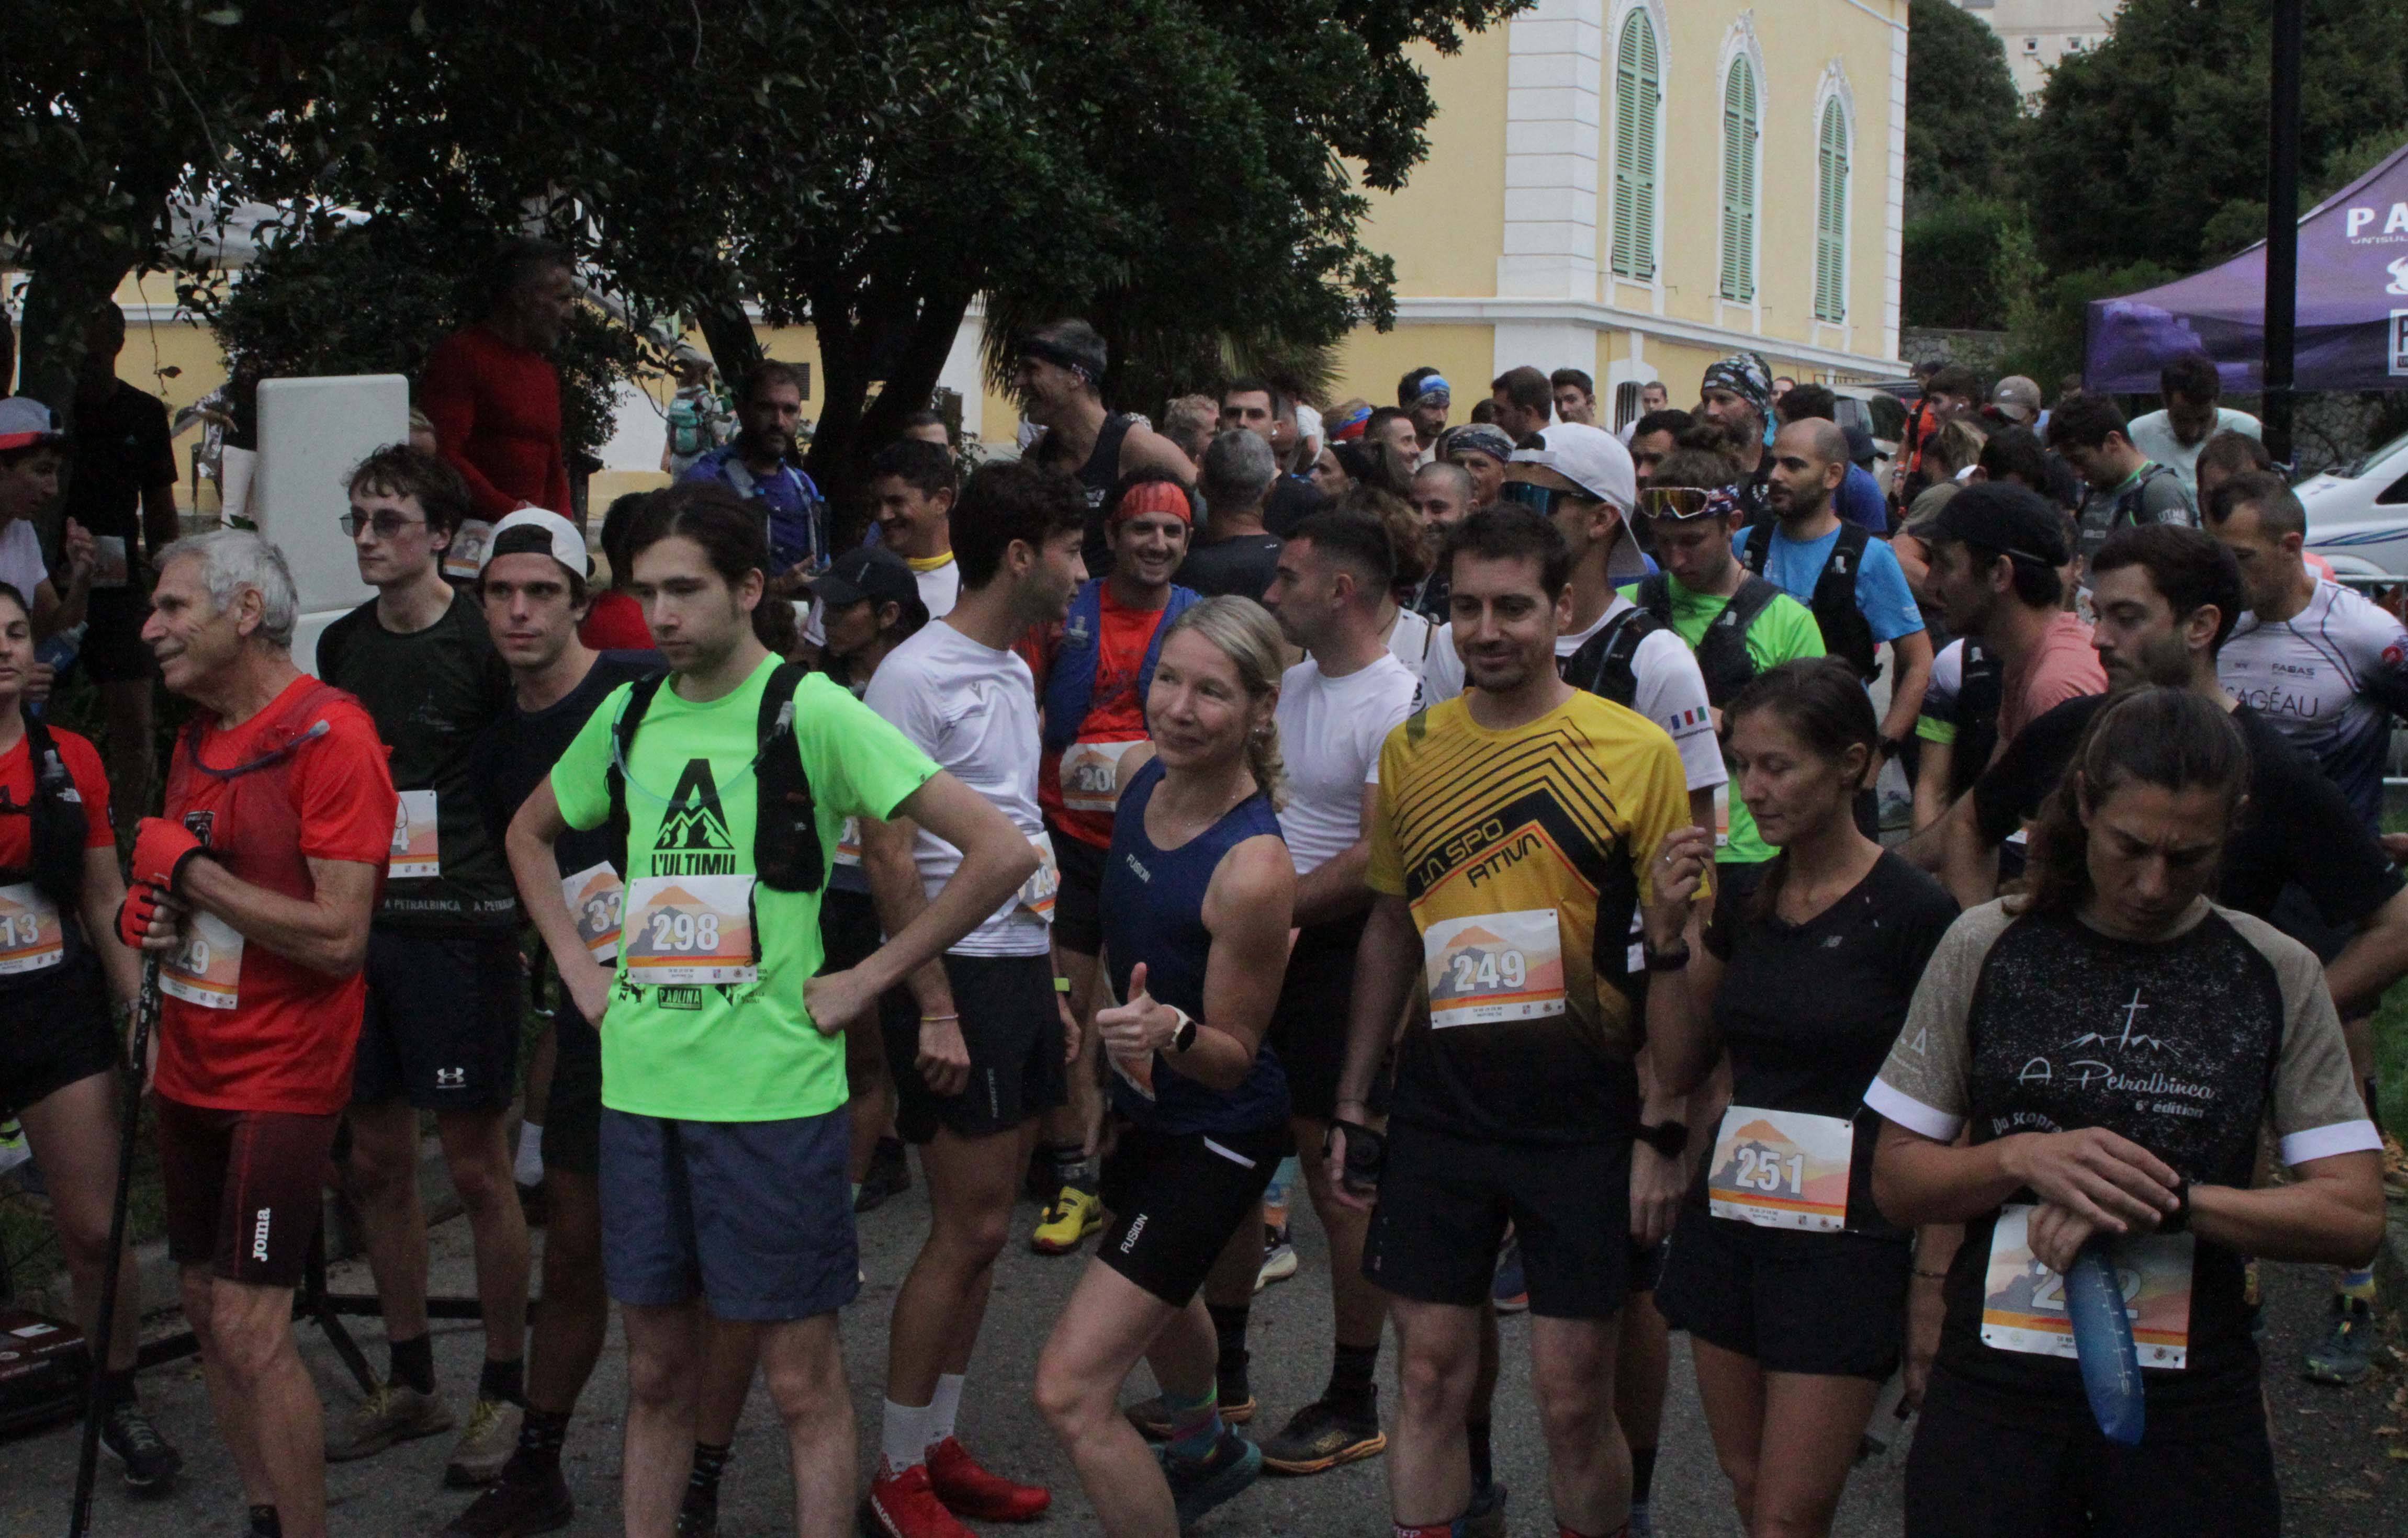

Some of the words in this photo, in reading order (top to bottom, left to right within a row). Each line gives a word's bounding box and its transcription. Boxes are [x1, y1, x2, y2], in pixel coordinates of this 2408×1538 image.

[2226, 686, 2319, 718] AGÉAU
[651, 853, 736, 877] L'ULTIMU
[652, 913, 720, 951] 298
[1453, 949, 1526, 992] 249
[1735, 1147, 1804, 1194] 251
[1120, 1213, 1149, 1254] FUSION
[2031, 1262, 2142, 1320] 22
